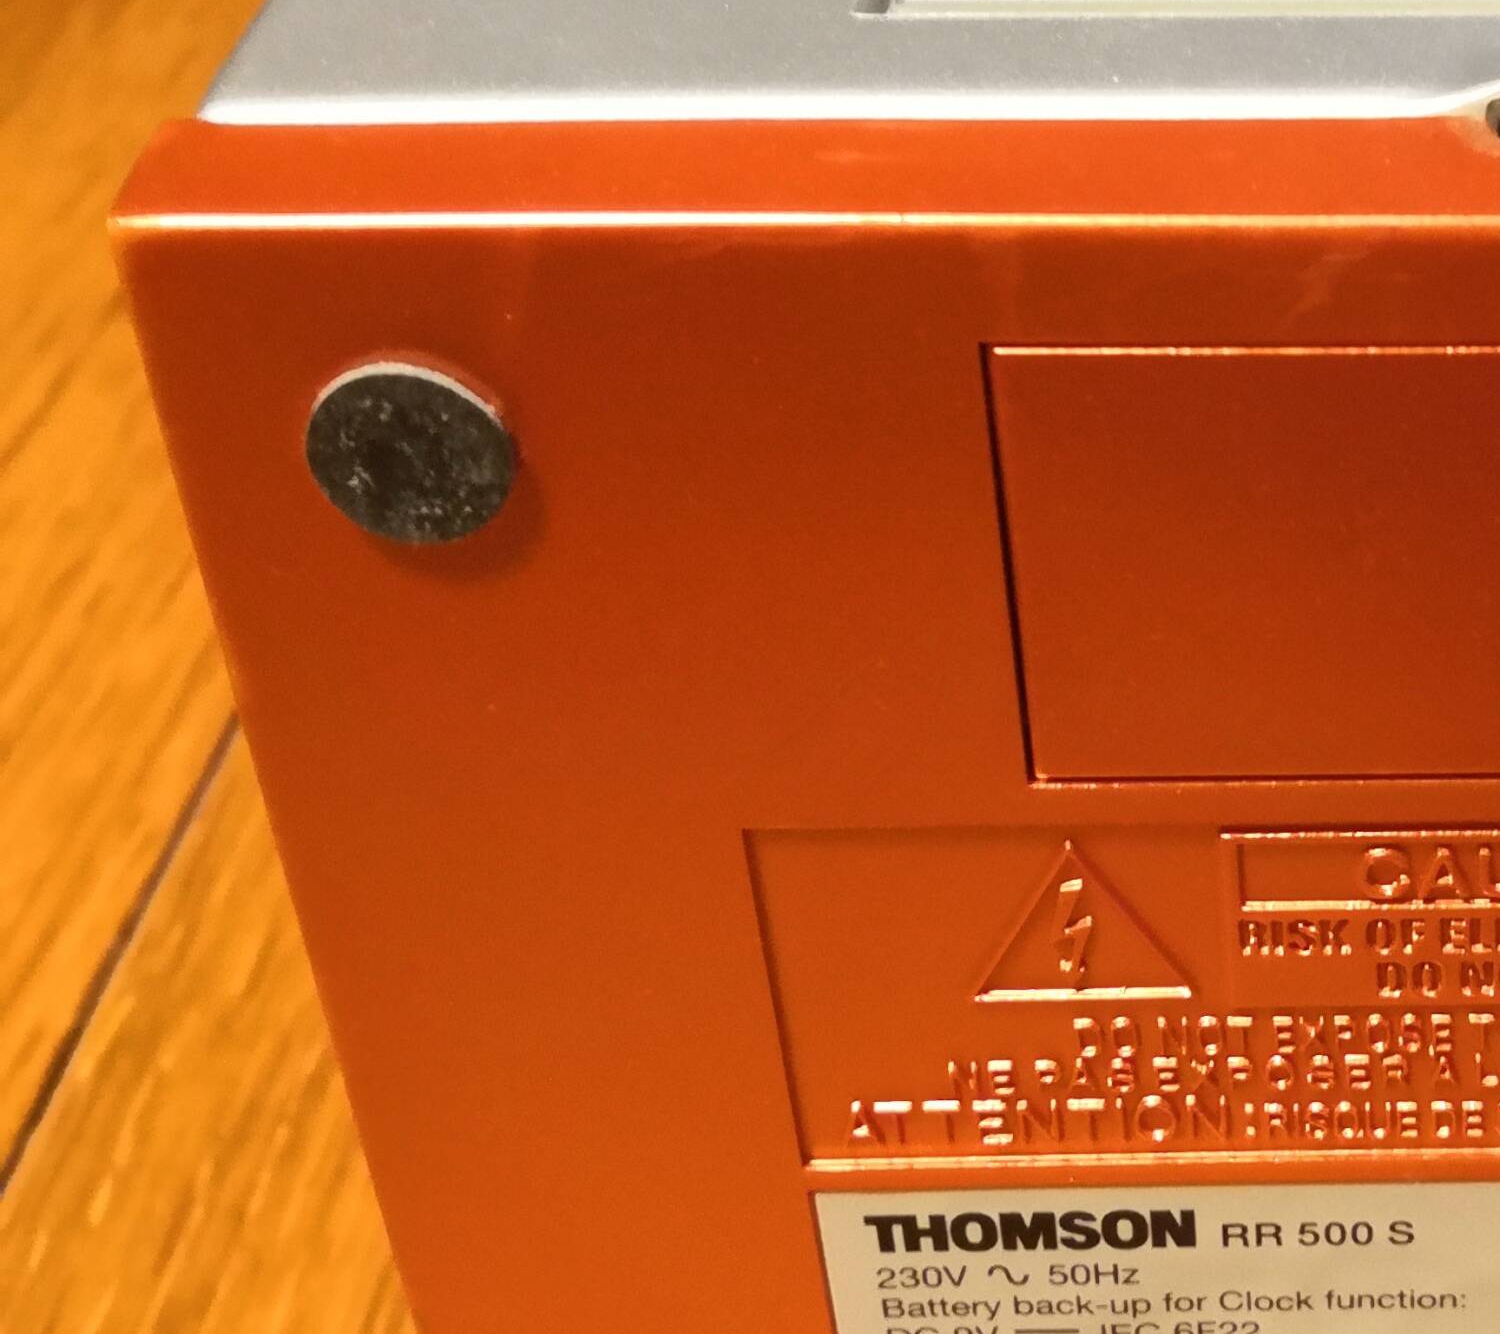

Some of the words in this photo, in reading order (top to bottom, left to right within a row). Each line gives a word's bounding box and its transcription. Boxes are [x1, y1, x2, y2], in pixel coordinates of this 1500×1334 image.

[1237, 918, 1351, 955] RISK
[1365, 918, 1425, 955] OF
[1376, 961, 1443, 998] DO
[1073, 1016, 1137, 1058] DO
[1156, 1015, 1253, 1056] NOT
[1273, 1013, 1453, 1054] EXPOSE
[948, 1058, 1015, 1096] NE
[1034, 1057, 1135, 1093] PAS
[1153, 1054, 1409, 1092] EXPOSER
[1430, 1099, 1484, 1138] DE
[865, 1209, 1197, 1253] THOMSON
[1222, 1222, 1283, 1248] RR
[1298, 1221, 1374, 1246] 500
[1388, 1220, 1415, 1246] S
[876, 1264, 967, 1289] 230V
[1049, 1262, 1141, 1286] 50Hz
[881, 1297, 1000, 1320] Battery
[1013, 1295, 1151, 1318] back-up
[1163, 1291, 1207, 1313] for
[1219, 1290, 1314, 1312] Clock
[1325, 1289, 1467, 1310] function:
